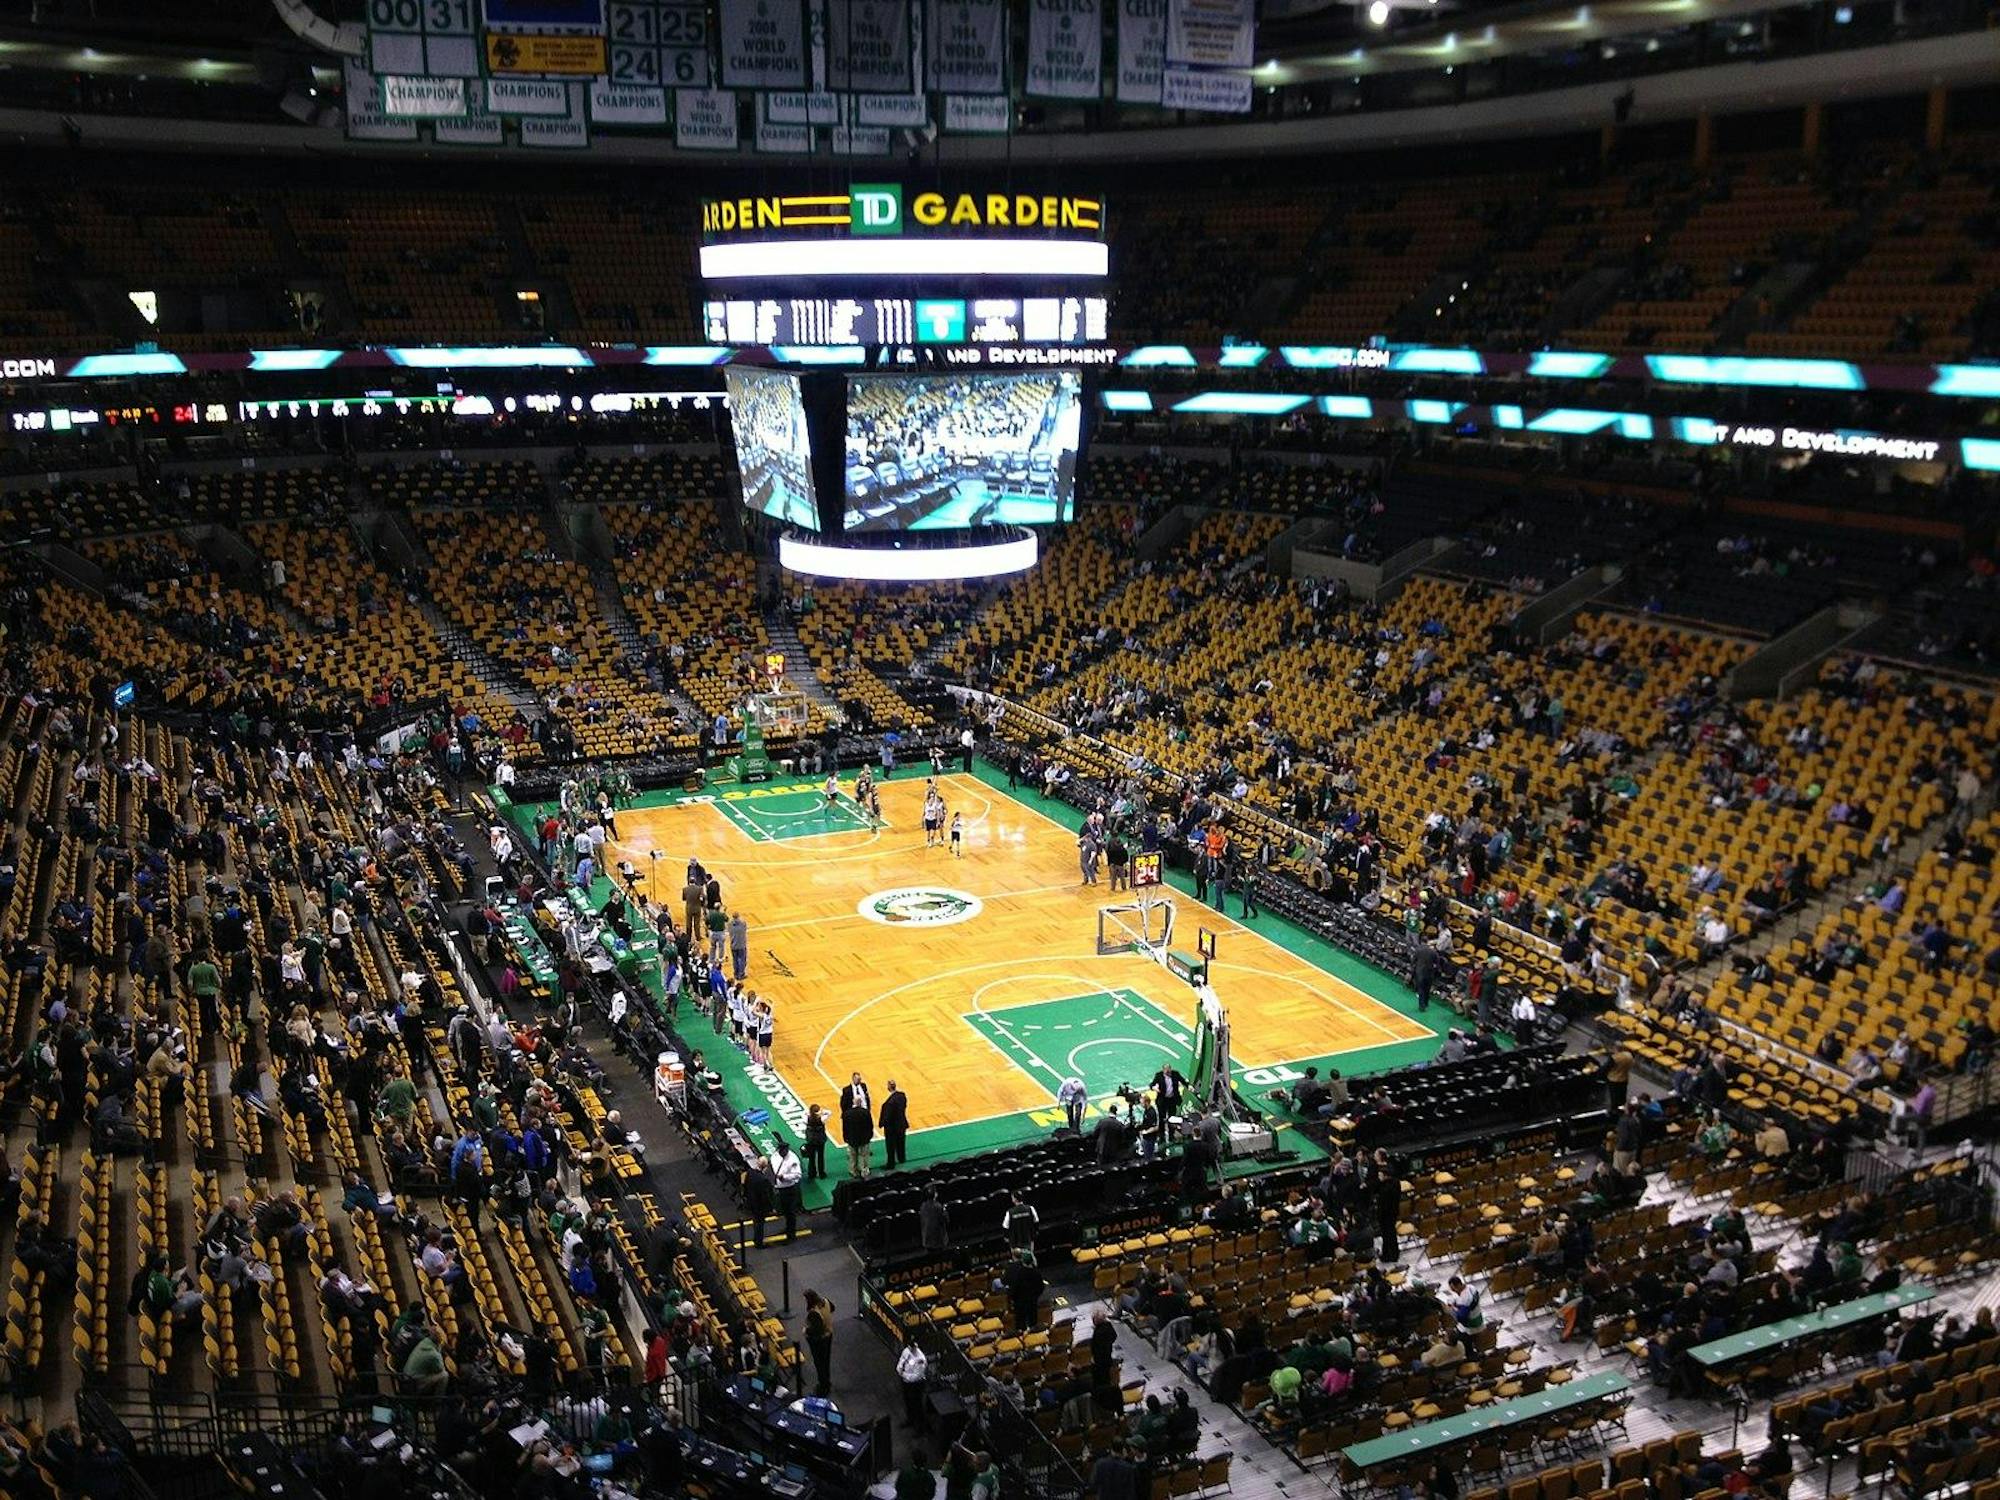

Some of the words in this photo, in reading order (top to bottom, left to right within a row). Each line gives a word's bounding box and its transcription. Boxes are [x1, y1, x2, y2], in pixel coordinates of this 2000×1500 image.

[615, 8, 652, 41] 21
[663, 10, 706, 42] 25
[749, 21, 777, 35] 2008
[743, 39, 786, 53] WORLD
[945, 45, 985, 59] WORLD
[614, 49, 656, 81] 24
[675, 51, 696, 82] 6
[730, 55, 800, 71] CHAMPIONS
[835, 57, 906, 75] CHAMPIONS
[932, 59, 999, 76] CHAMPIONS
[1031, 65, 1096, 83] CHAMPIONS
[391, 85, 461, 99] CHAMPIONS
[494, 82, 561, 99] CHAMPIONS
[596, 93, 661, 108] CHAMPIONS
[864, 97, 922, 112] CHAMPIONS
[690, 111, 722, 125] WORLD
[526, 120, 582, 135] CHAMPIONS
[680, 125, 734, 139] CHAMPIONS
[854, 192, 898, 226] TD
[912, 192, 1082, 228] GARDEN
[1731, 426, 1776, 447] AND
[1135, 865, 1159, 885] 24
[1100, 1215, 1162, 1236] GARDEN
[887, 1263, 954, 1285] GARDEN
